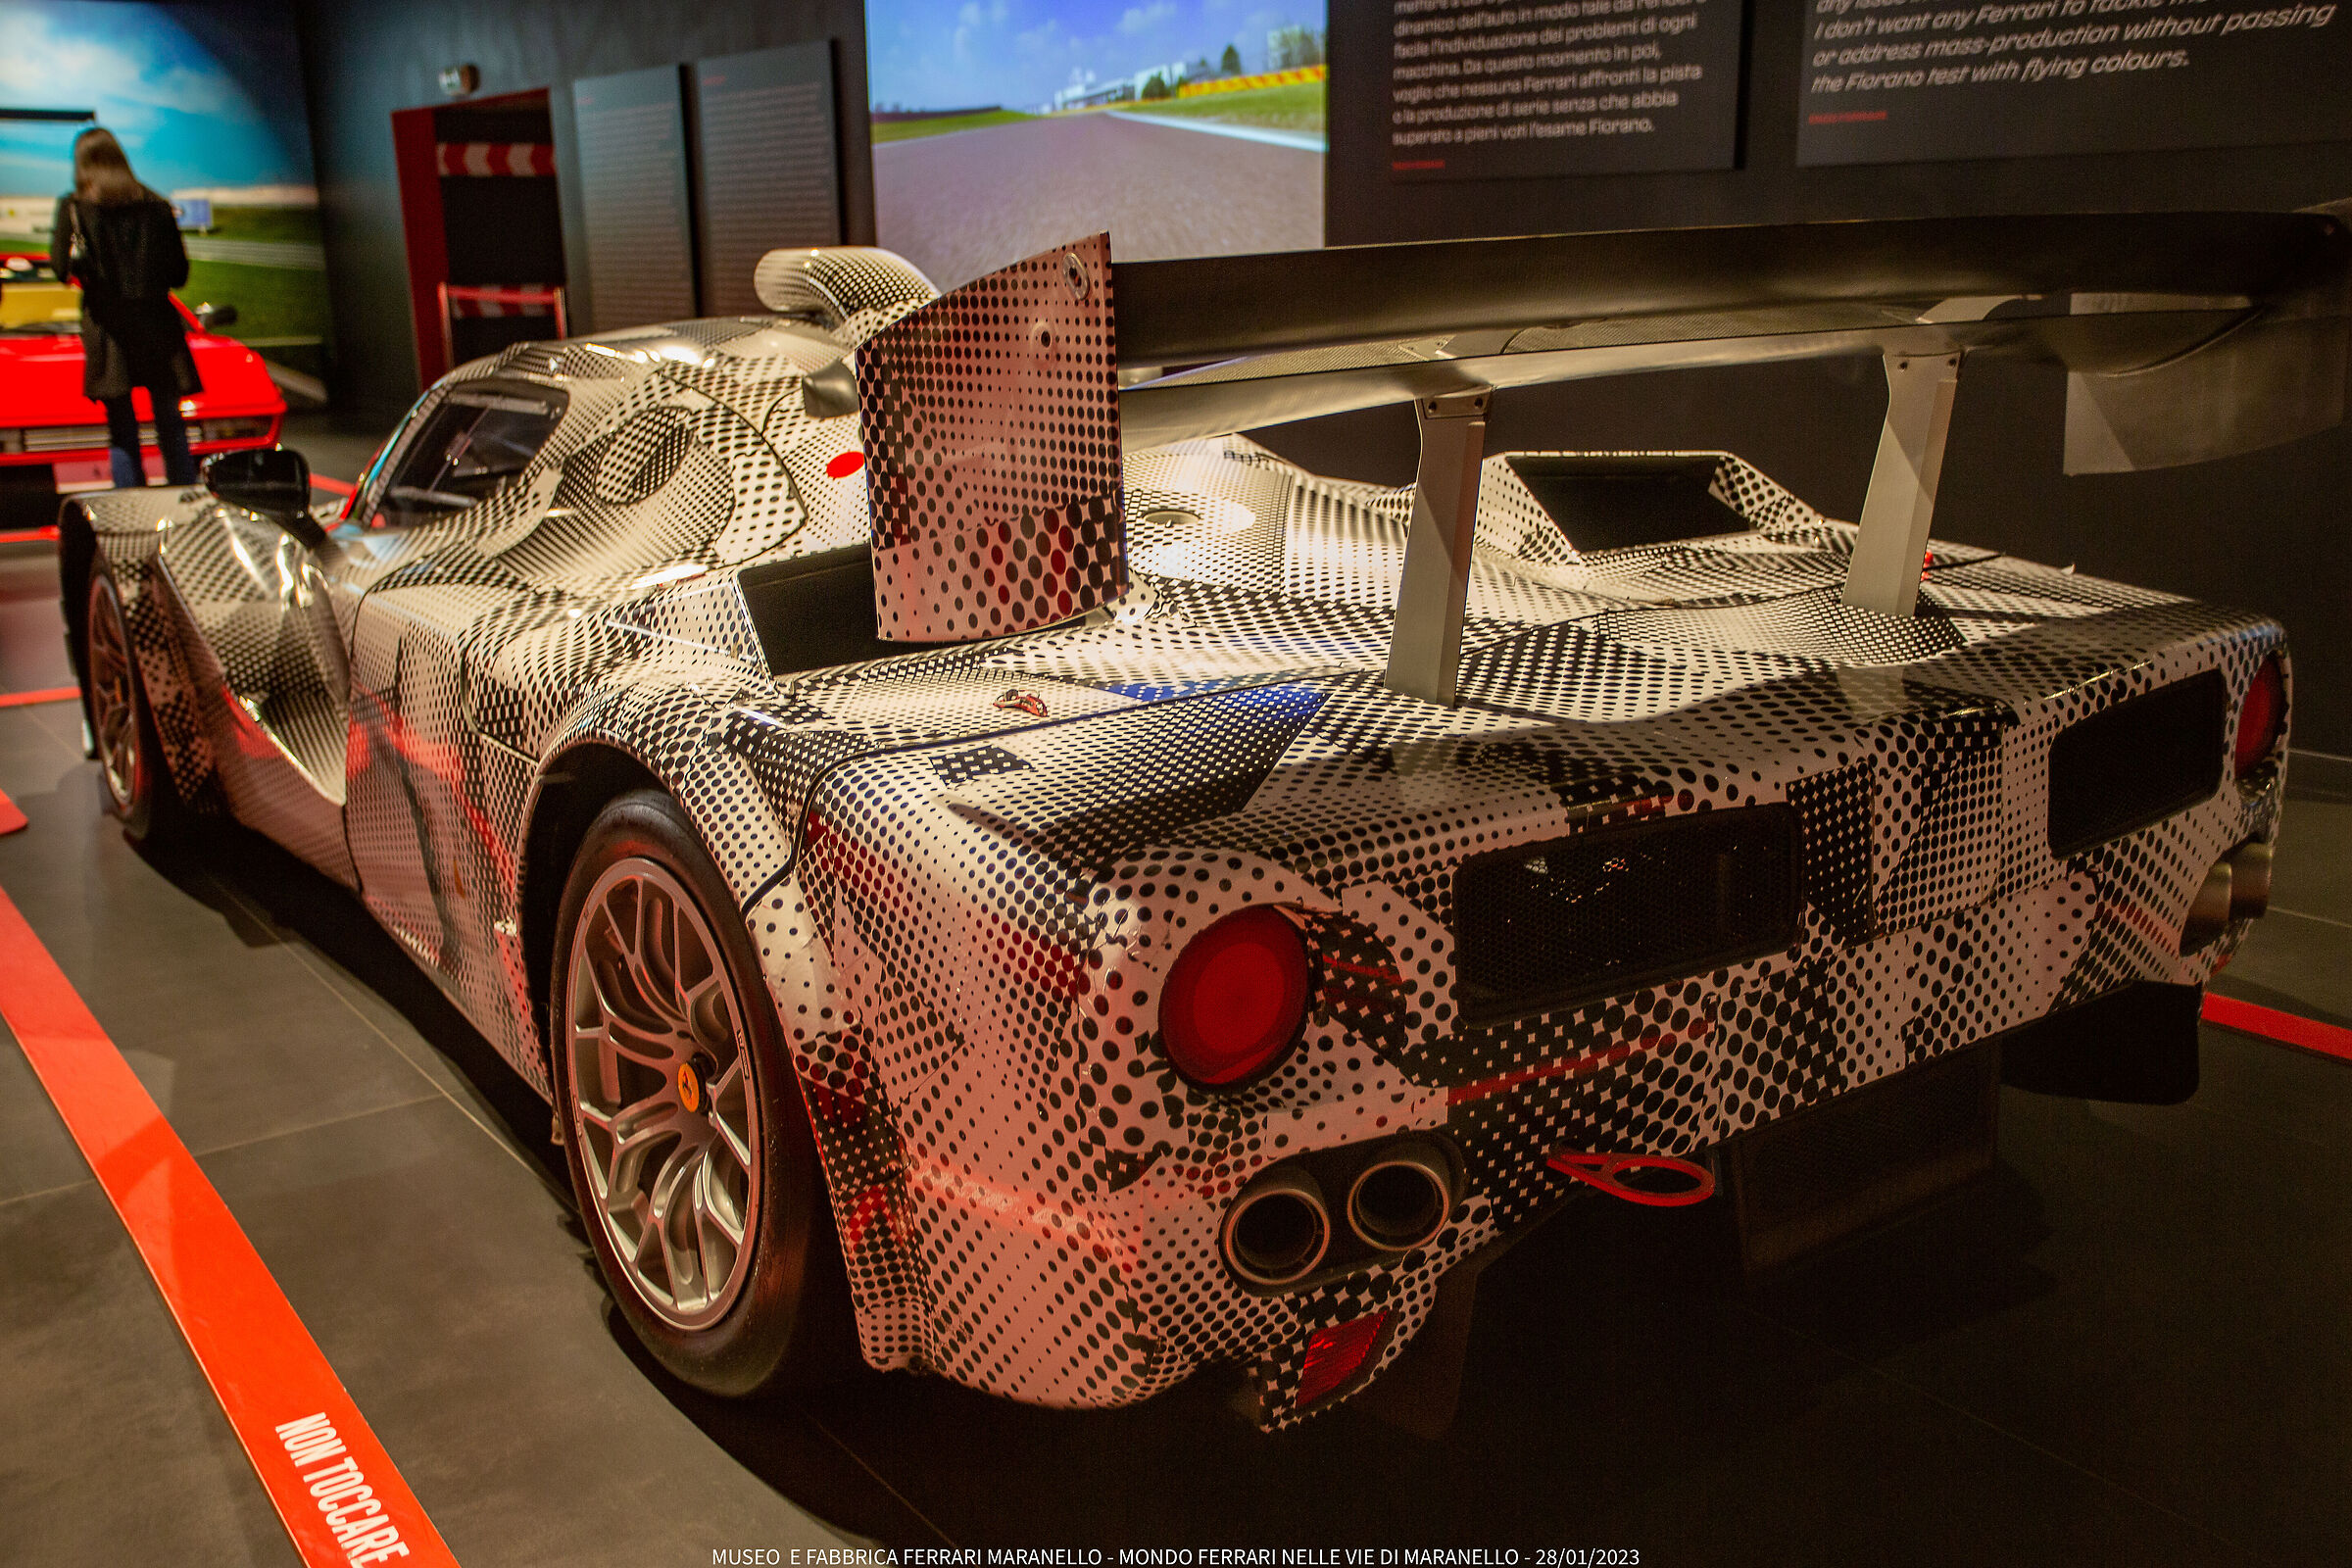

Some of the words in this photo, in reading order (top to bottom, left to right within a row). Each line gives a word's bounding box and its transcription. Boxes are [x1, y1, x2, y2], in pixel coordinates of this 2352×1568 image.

[1565, 18, 1640, 45] problemi
[1641, 16, 1657, 33] di
[1659, 12, 1698, 35] ogni
[1812, 47, 1838, 68] or
[1838, 40, 1924, 66] address
[1924, 22, 2121, 59] mass-production
[2123, 12, 2224, 41] without
[2220, 3, 2337, 36] passing
[1825, 15, 1876, 40] don't
[1877, 12, 1933, 35] want
[1931, 9, 1977, 31] any
[1975, 0, 2061, 24] Ferrari
[1523, 73, 1579, 93] Ferrari
[1811, 74, 1844, 94] the
[1845, 69, 1926, 92] Fiorano
[1927, 64, 1972, 86] test
[1970, 59, 2022, 83] with
[2020, 53, 2089, 82] flying
[2089, 48, 2189, 75] colours.
[1598, 91, 1630, 111] che
[1631, 89, 1679, 110] abbia
[275, 1412, 346, 1467] NON
[303, 1456, 410, 1568] TOCCARE
